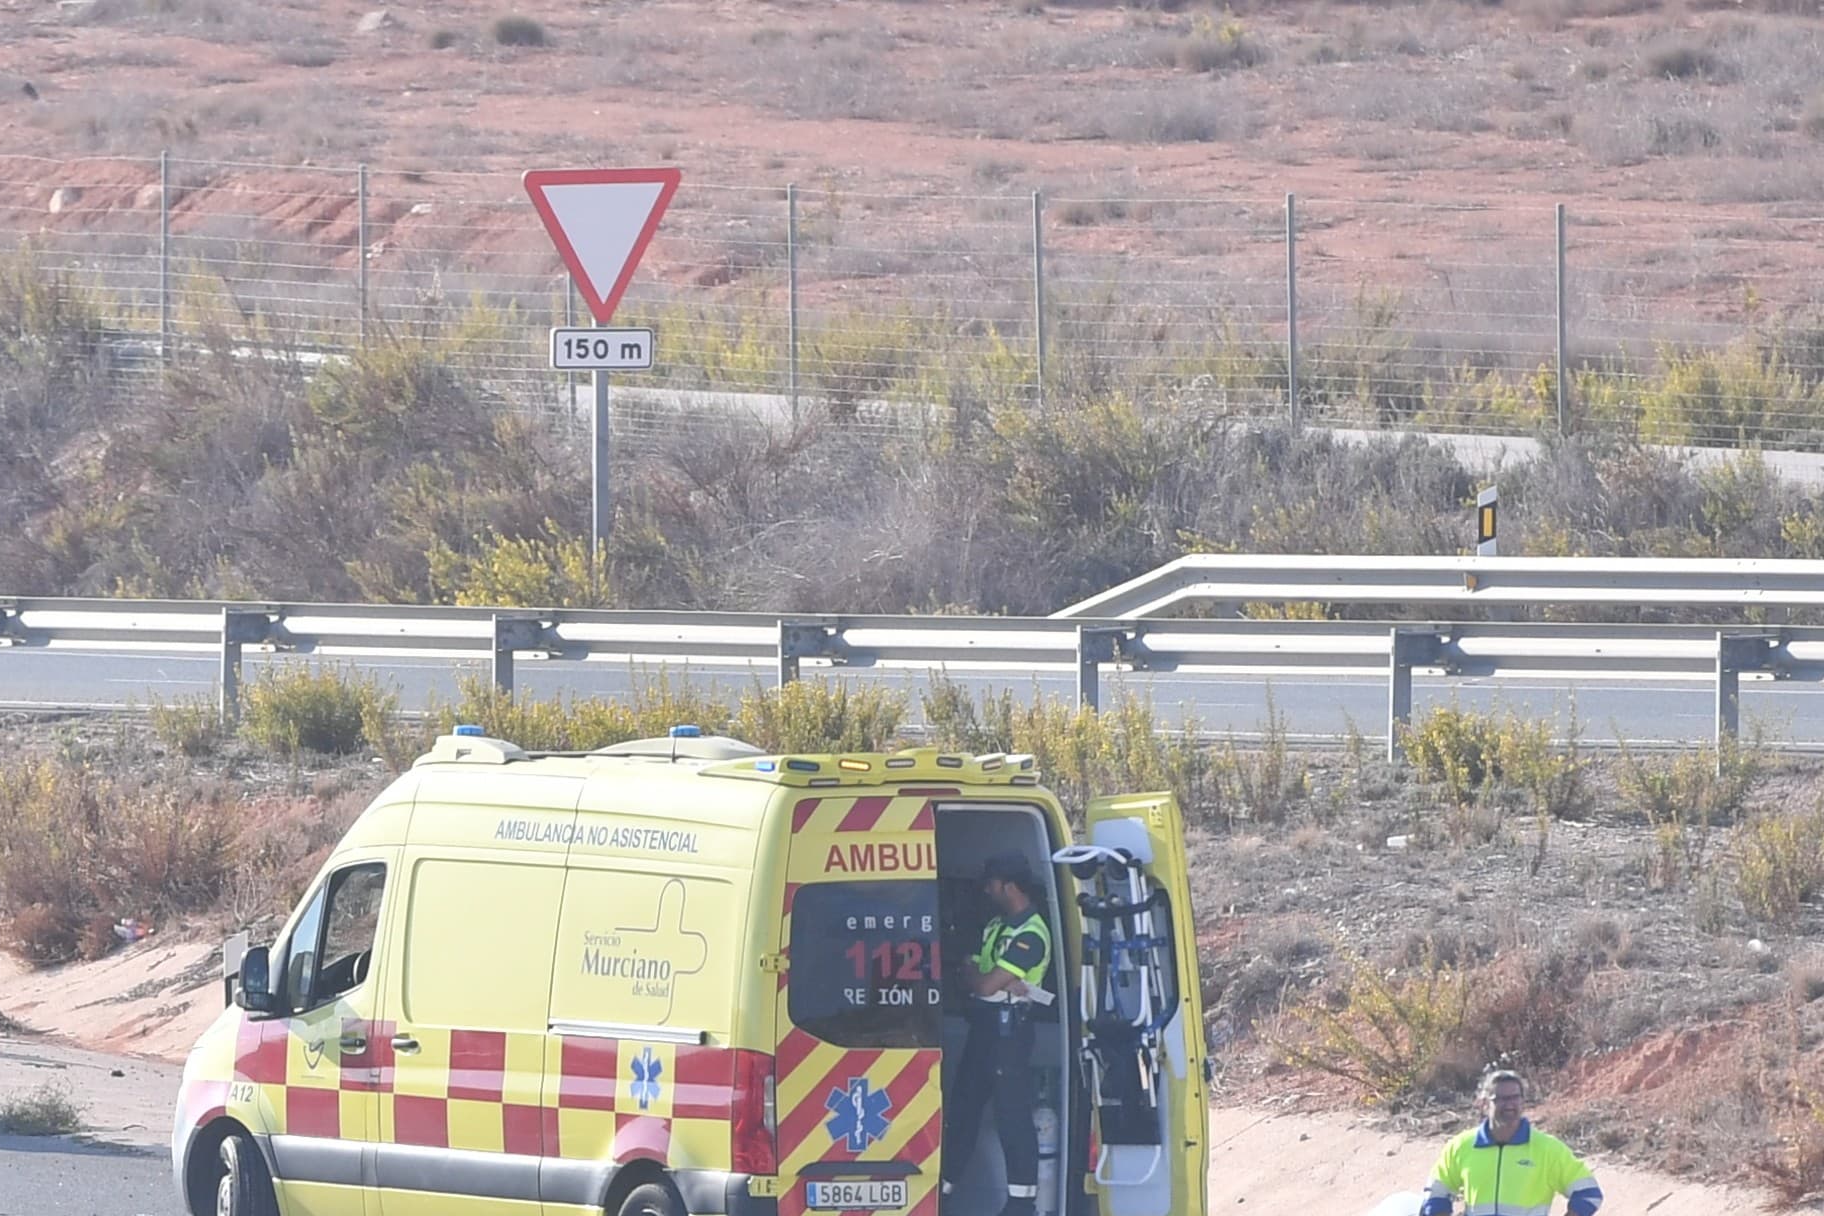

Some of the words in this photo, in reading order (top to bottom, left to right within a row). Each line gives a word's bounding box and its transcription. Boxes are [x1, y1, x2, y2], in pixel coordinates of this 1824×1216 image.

[563, 338, 609, 360] 150
[620, 342, 642, 360] m
[494, 819, 585, 844] AMBULANCIA
[586, 826, 609, 845] NO
[609, 829, 699, 853] ASISTENCIAL
[846, 914, 933, 933] emerg
[583, 930, 622, 947] Servicio
[581, 947, 671, 981] Murciano
[631, 981, 643, 997] de
[645, 982, 670, 998] Salud
[231, 1084, 254, 1103] A12
[820, 1184, 863, 1203] 5864
[869, 1184, 902, 1203] LGB
